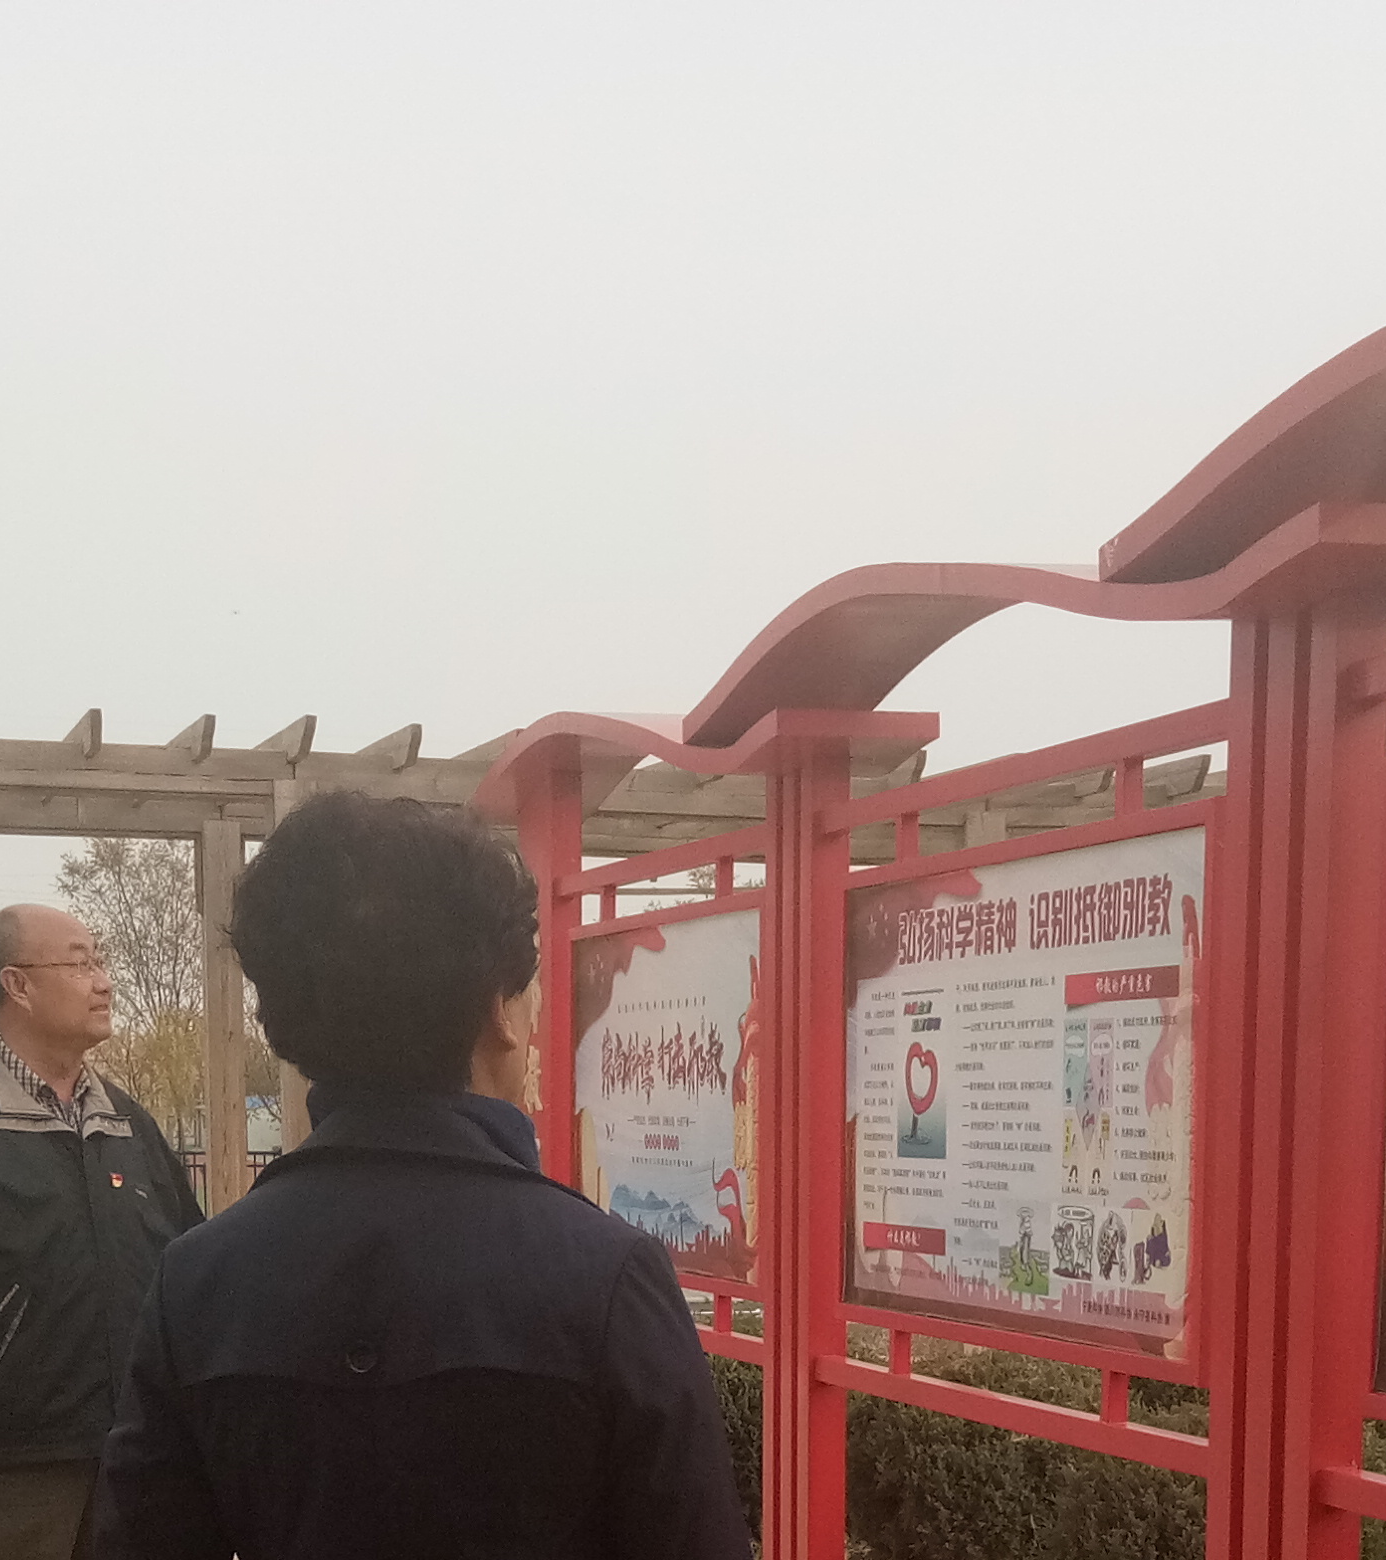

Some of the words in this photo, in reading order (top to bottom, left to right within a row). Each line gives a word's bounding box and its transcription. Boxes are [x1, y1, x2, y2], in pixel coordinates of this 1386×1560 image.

[897, 897, 1017, 966] 弘扬科学精神
[1029, 873, 1173, 950] 识别抵御邪教
